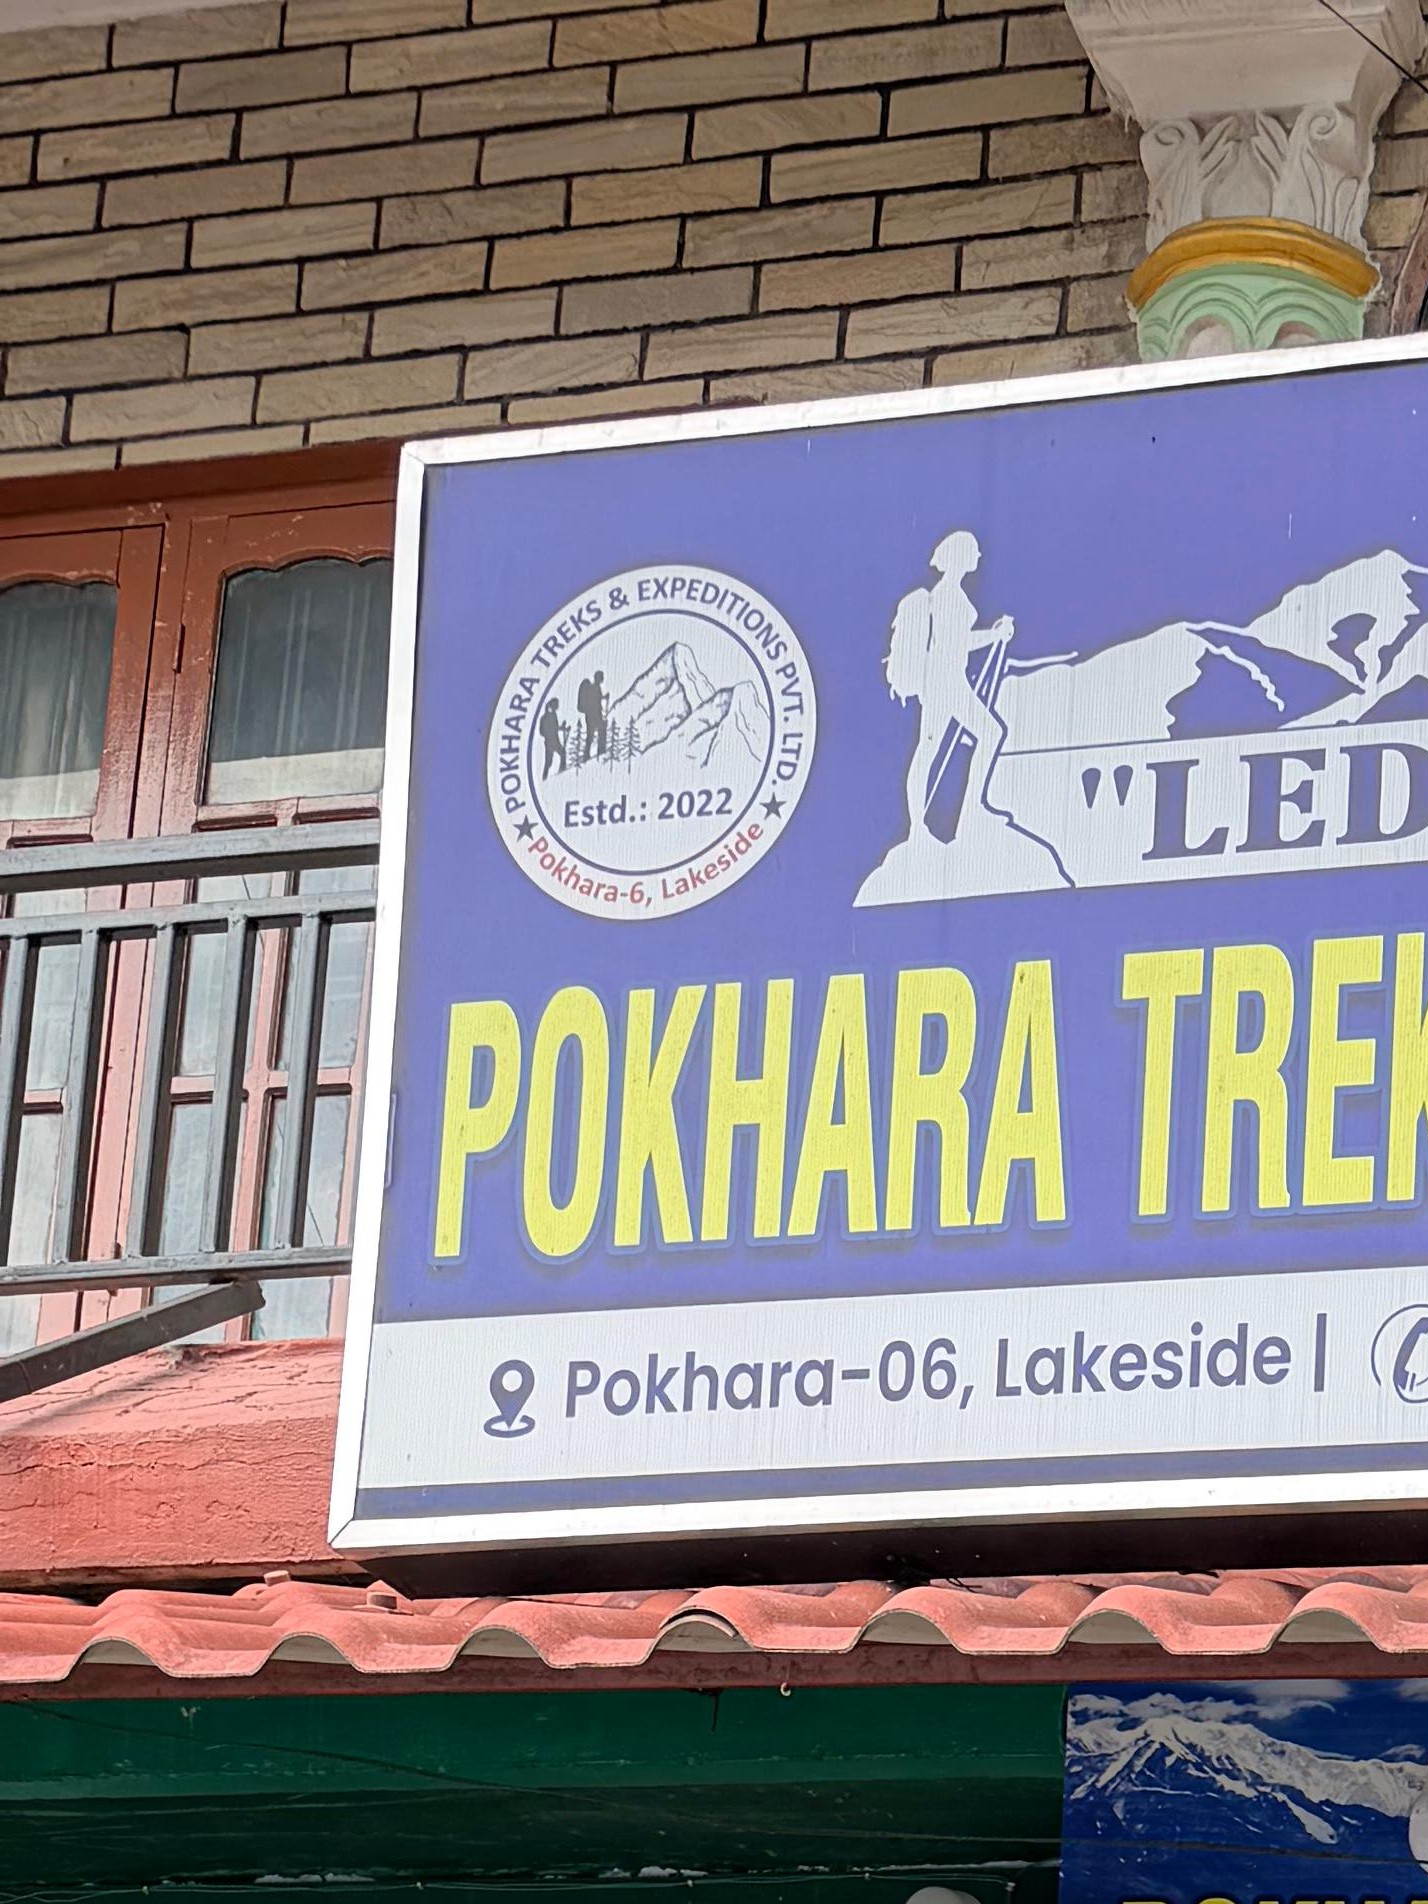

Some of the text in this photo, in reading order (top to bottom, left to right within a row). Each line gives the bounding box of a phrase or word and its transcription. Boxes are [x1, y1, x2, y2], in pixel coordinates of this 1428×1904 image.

[500, 576, 804, 814] POKHARA TREKS & EXPEDITIONS PVT. LTD.
[563, 787, 733, 828] Estd.: 2022
[528, 821, 764, 908] Pokhara-6, Lakeside
[433, 959, 1068, 1261] POKHARA
[562, 1344, 975, 1422] Pokhara-06,
[994, 1323, 1294, 1402] Lakeside
